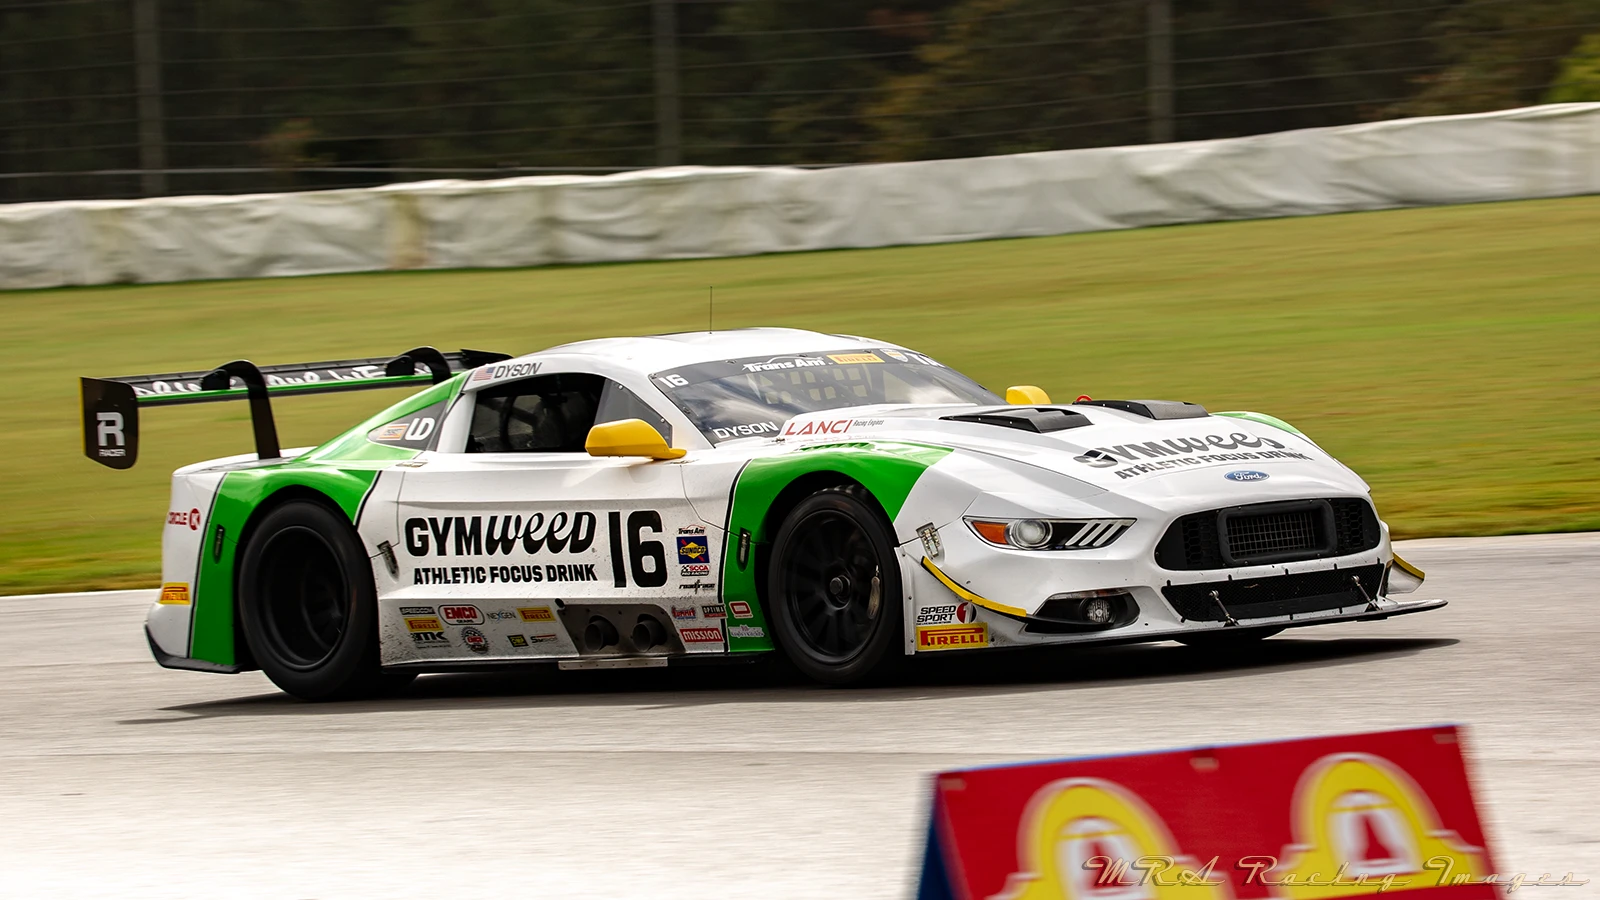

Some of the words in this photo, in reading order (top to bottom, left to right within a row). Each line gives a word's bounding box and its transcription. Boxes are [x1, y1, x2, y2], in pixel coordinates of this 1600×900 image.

[494, 362, 542, 379] DYSON
[741, 360, 794, 373] Trans
[795, 357, 827, 369] Am
[658, 374, 689, 389] 16
[96, 411, 125, 446] R
[712, 421, 779, 439] DYSON
[785, 419, 853, 436] LANCI
[99, 449, 126, 457] RACER
[1114, 457, 1196, 480] ATHLETIC
[1197, 451, 1252, 464] FOCUS
[1253, 449, 1315, 462] DRINK
[1233, 471, 1263, 481] Ford
[608, 510, 668, 588] 16
[681, 546, 706, 554] SUNOCO
[413, 566, 486, 585] ATHLETIC
[490, 564, 544, 583] FOCUS
[545, 563, 598, 582] DRINK
[443, 606, 478, 620] EMCO
[520, 609, 552, 620] PIRELLI
[703, 605, 725, 614] OPTIMA
[920, 605, 957, 615] SPEED
[408, 619, 440, 630] PIRELLI
[916, 613, 956, 623] SPORT
[683, 630, 722, 641] mission
[920, 628, 985, 646] PIRELLI
